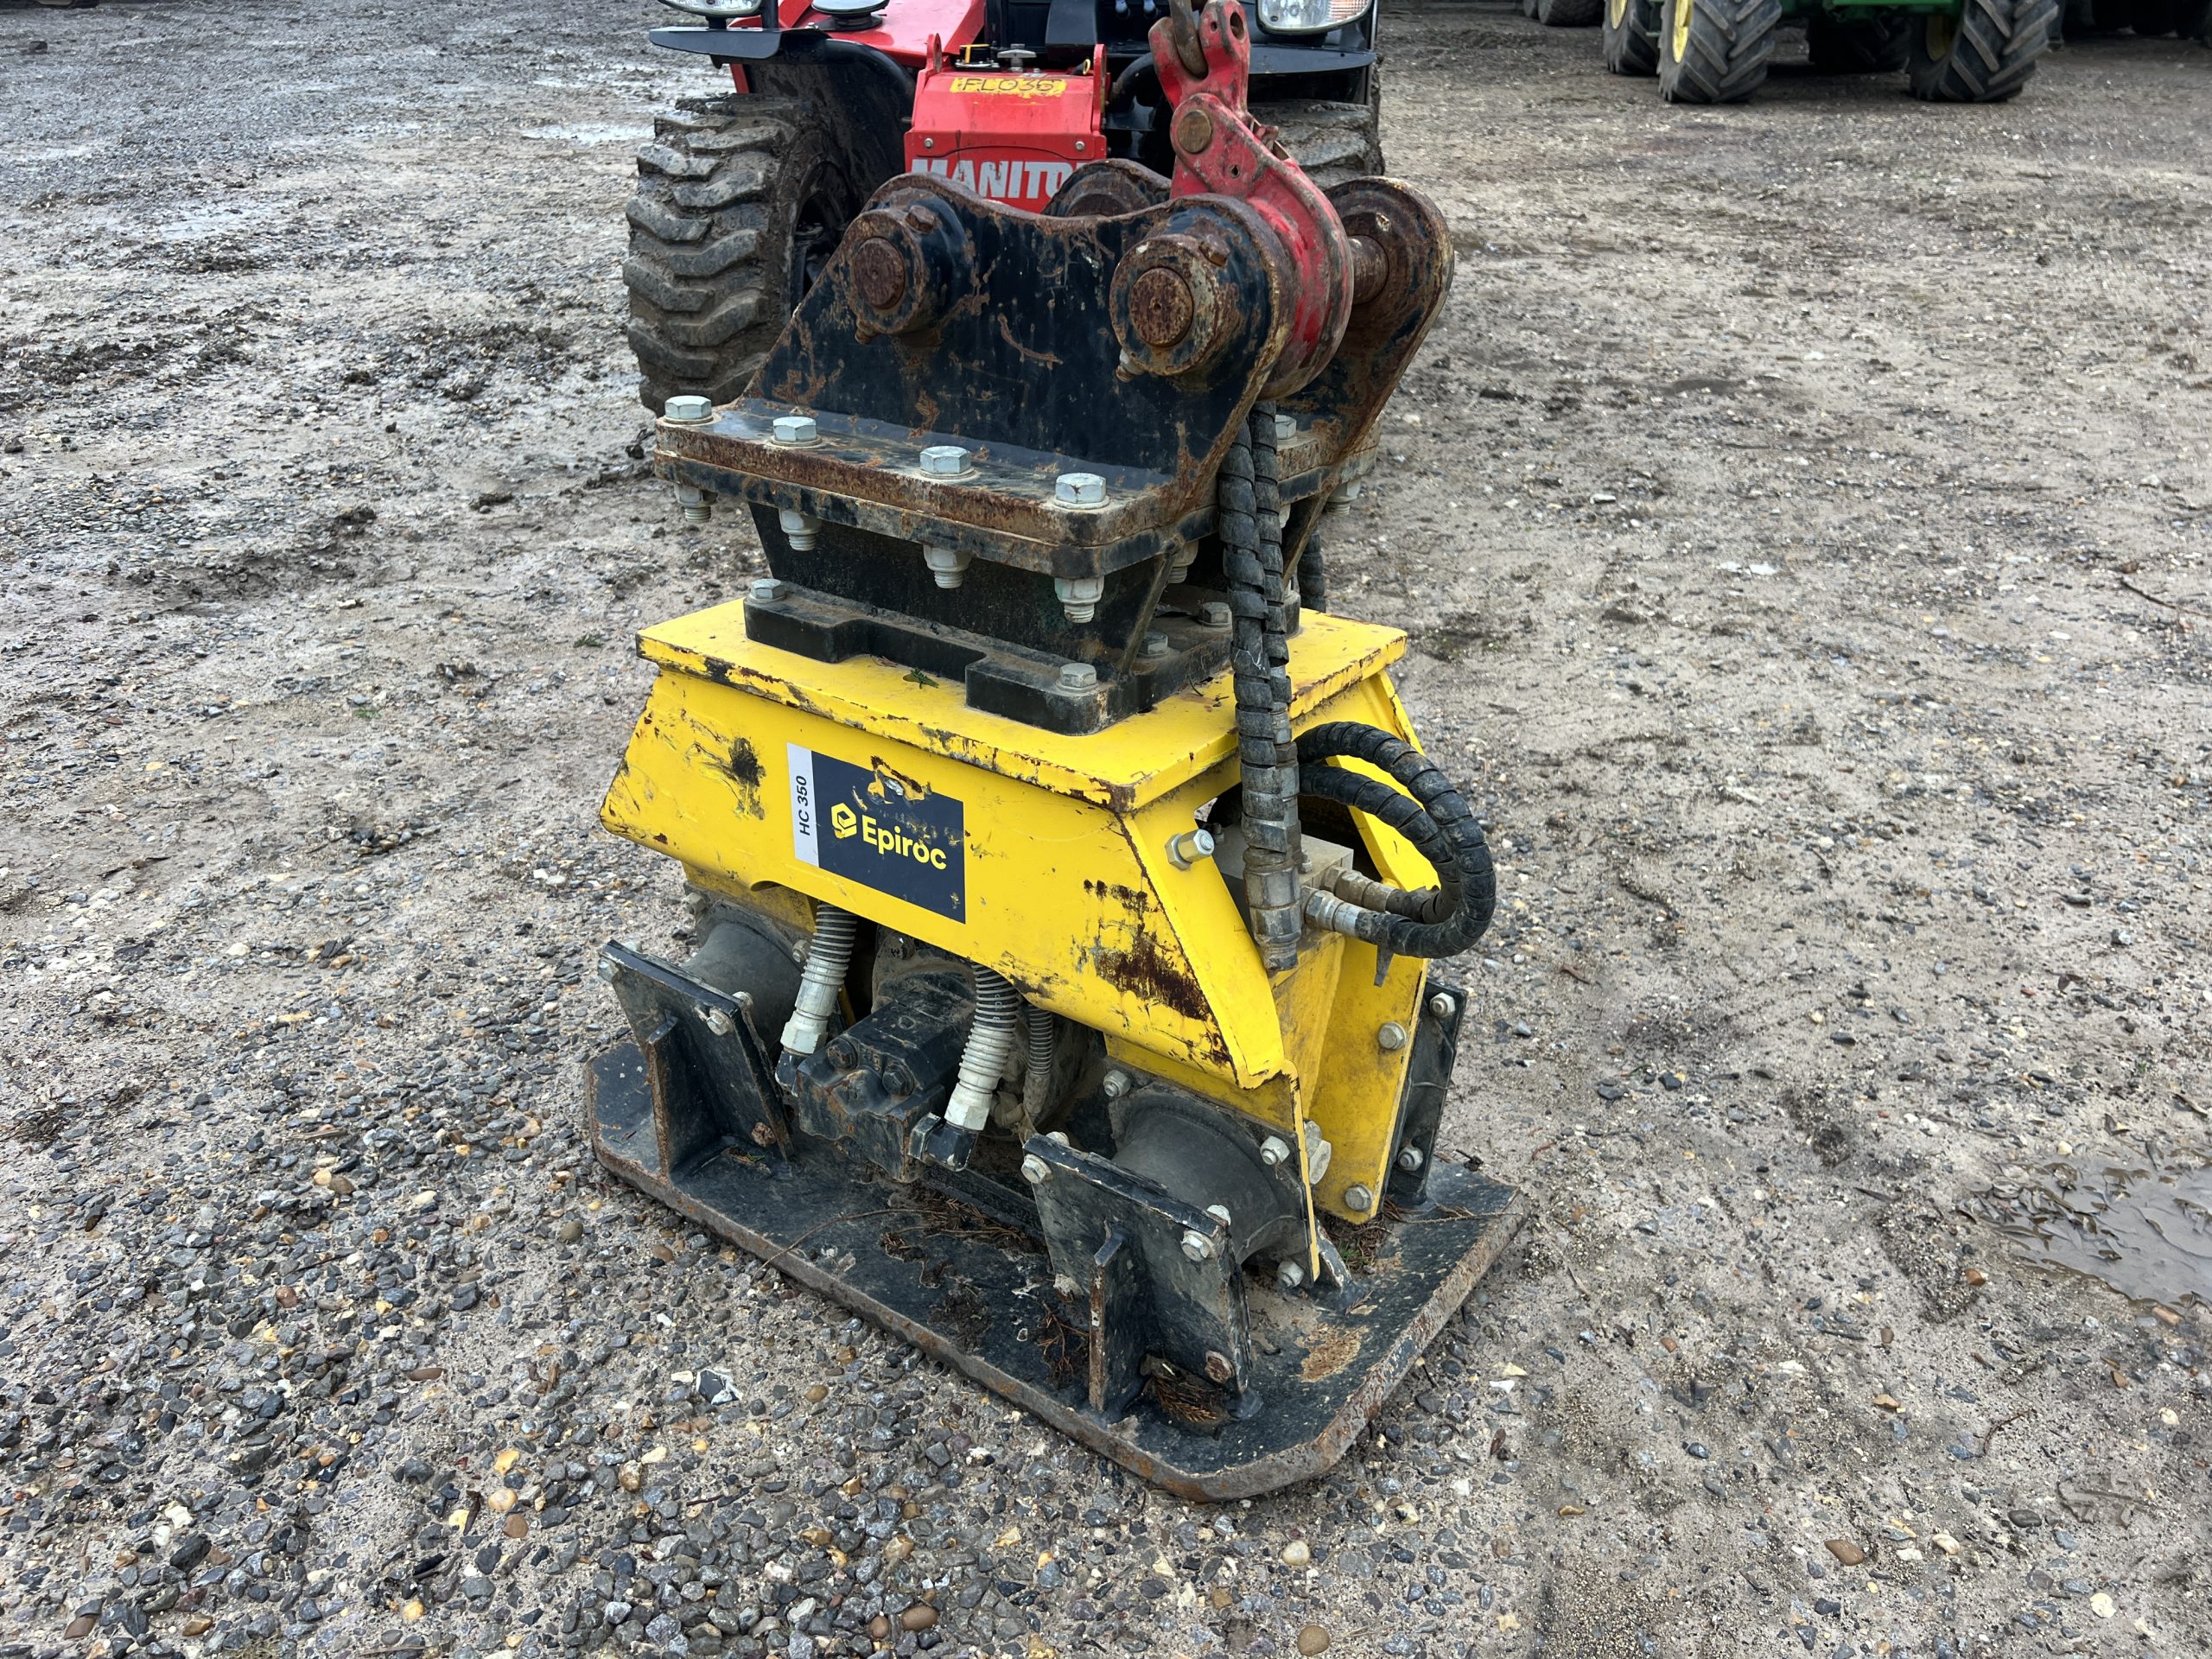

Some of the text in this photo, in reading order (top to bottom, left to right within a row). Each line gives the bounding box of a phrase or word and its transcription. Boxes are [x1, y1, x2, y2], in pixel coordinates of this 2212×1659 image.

[911, 158, 1090, 200] ANITO
[795, 775, 810, 836] HC 350
[861, 814, 947, 870] Epiroc
